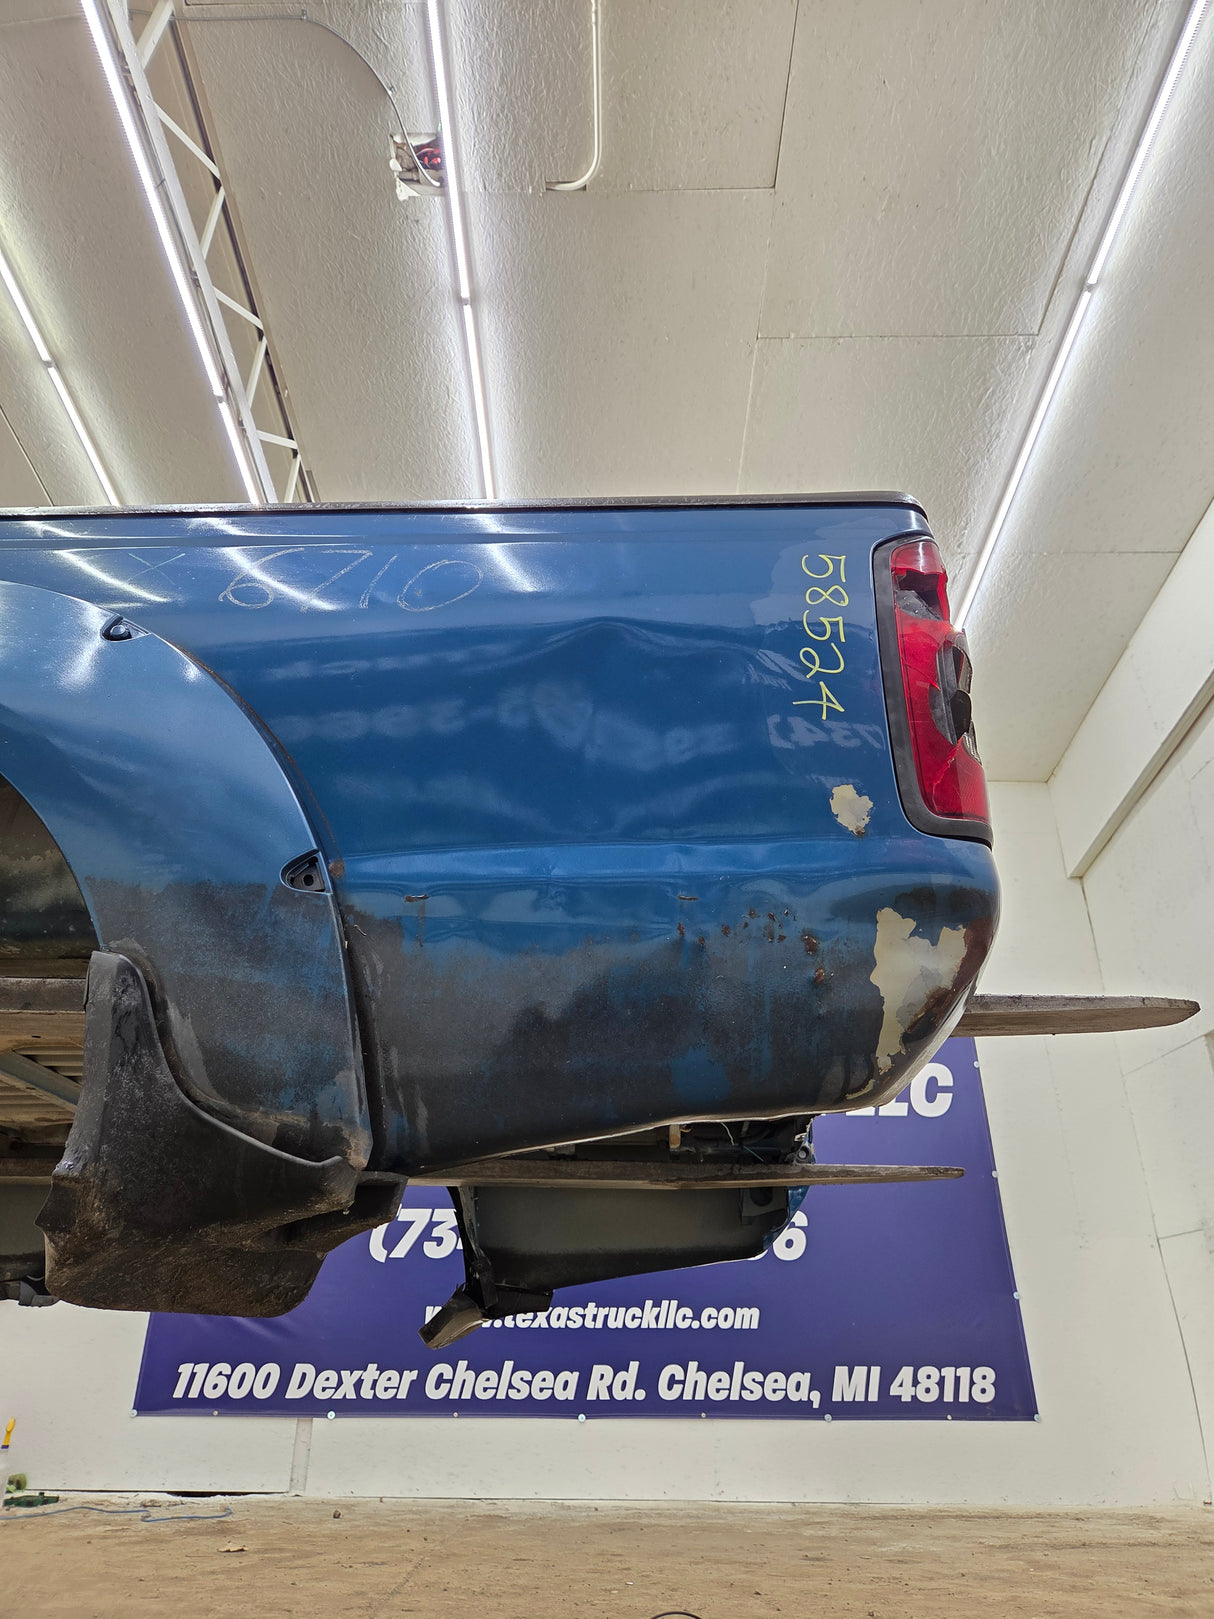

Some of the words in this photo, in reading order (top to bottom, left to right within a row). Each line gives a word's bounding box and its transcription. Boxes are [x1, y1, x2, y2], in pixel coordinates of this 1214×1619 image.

[218, 547, 484, 613] 6710
[791, 554, 849, 721] 58524
[172, 1362, 281, 1400] 11600
[284, 1362, 418, 1400] Dexter
[424, 1360, 579, 1401] Chelsea
[586, 1360, 647, 1401] Rd.
[657, 1361, 821, 1408] Chelsea,
[831, 1365, 881, 1402] MI
[889, 1366, 996, 1403] 48118
